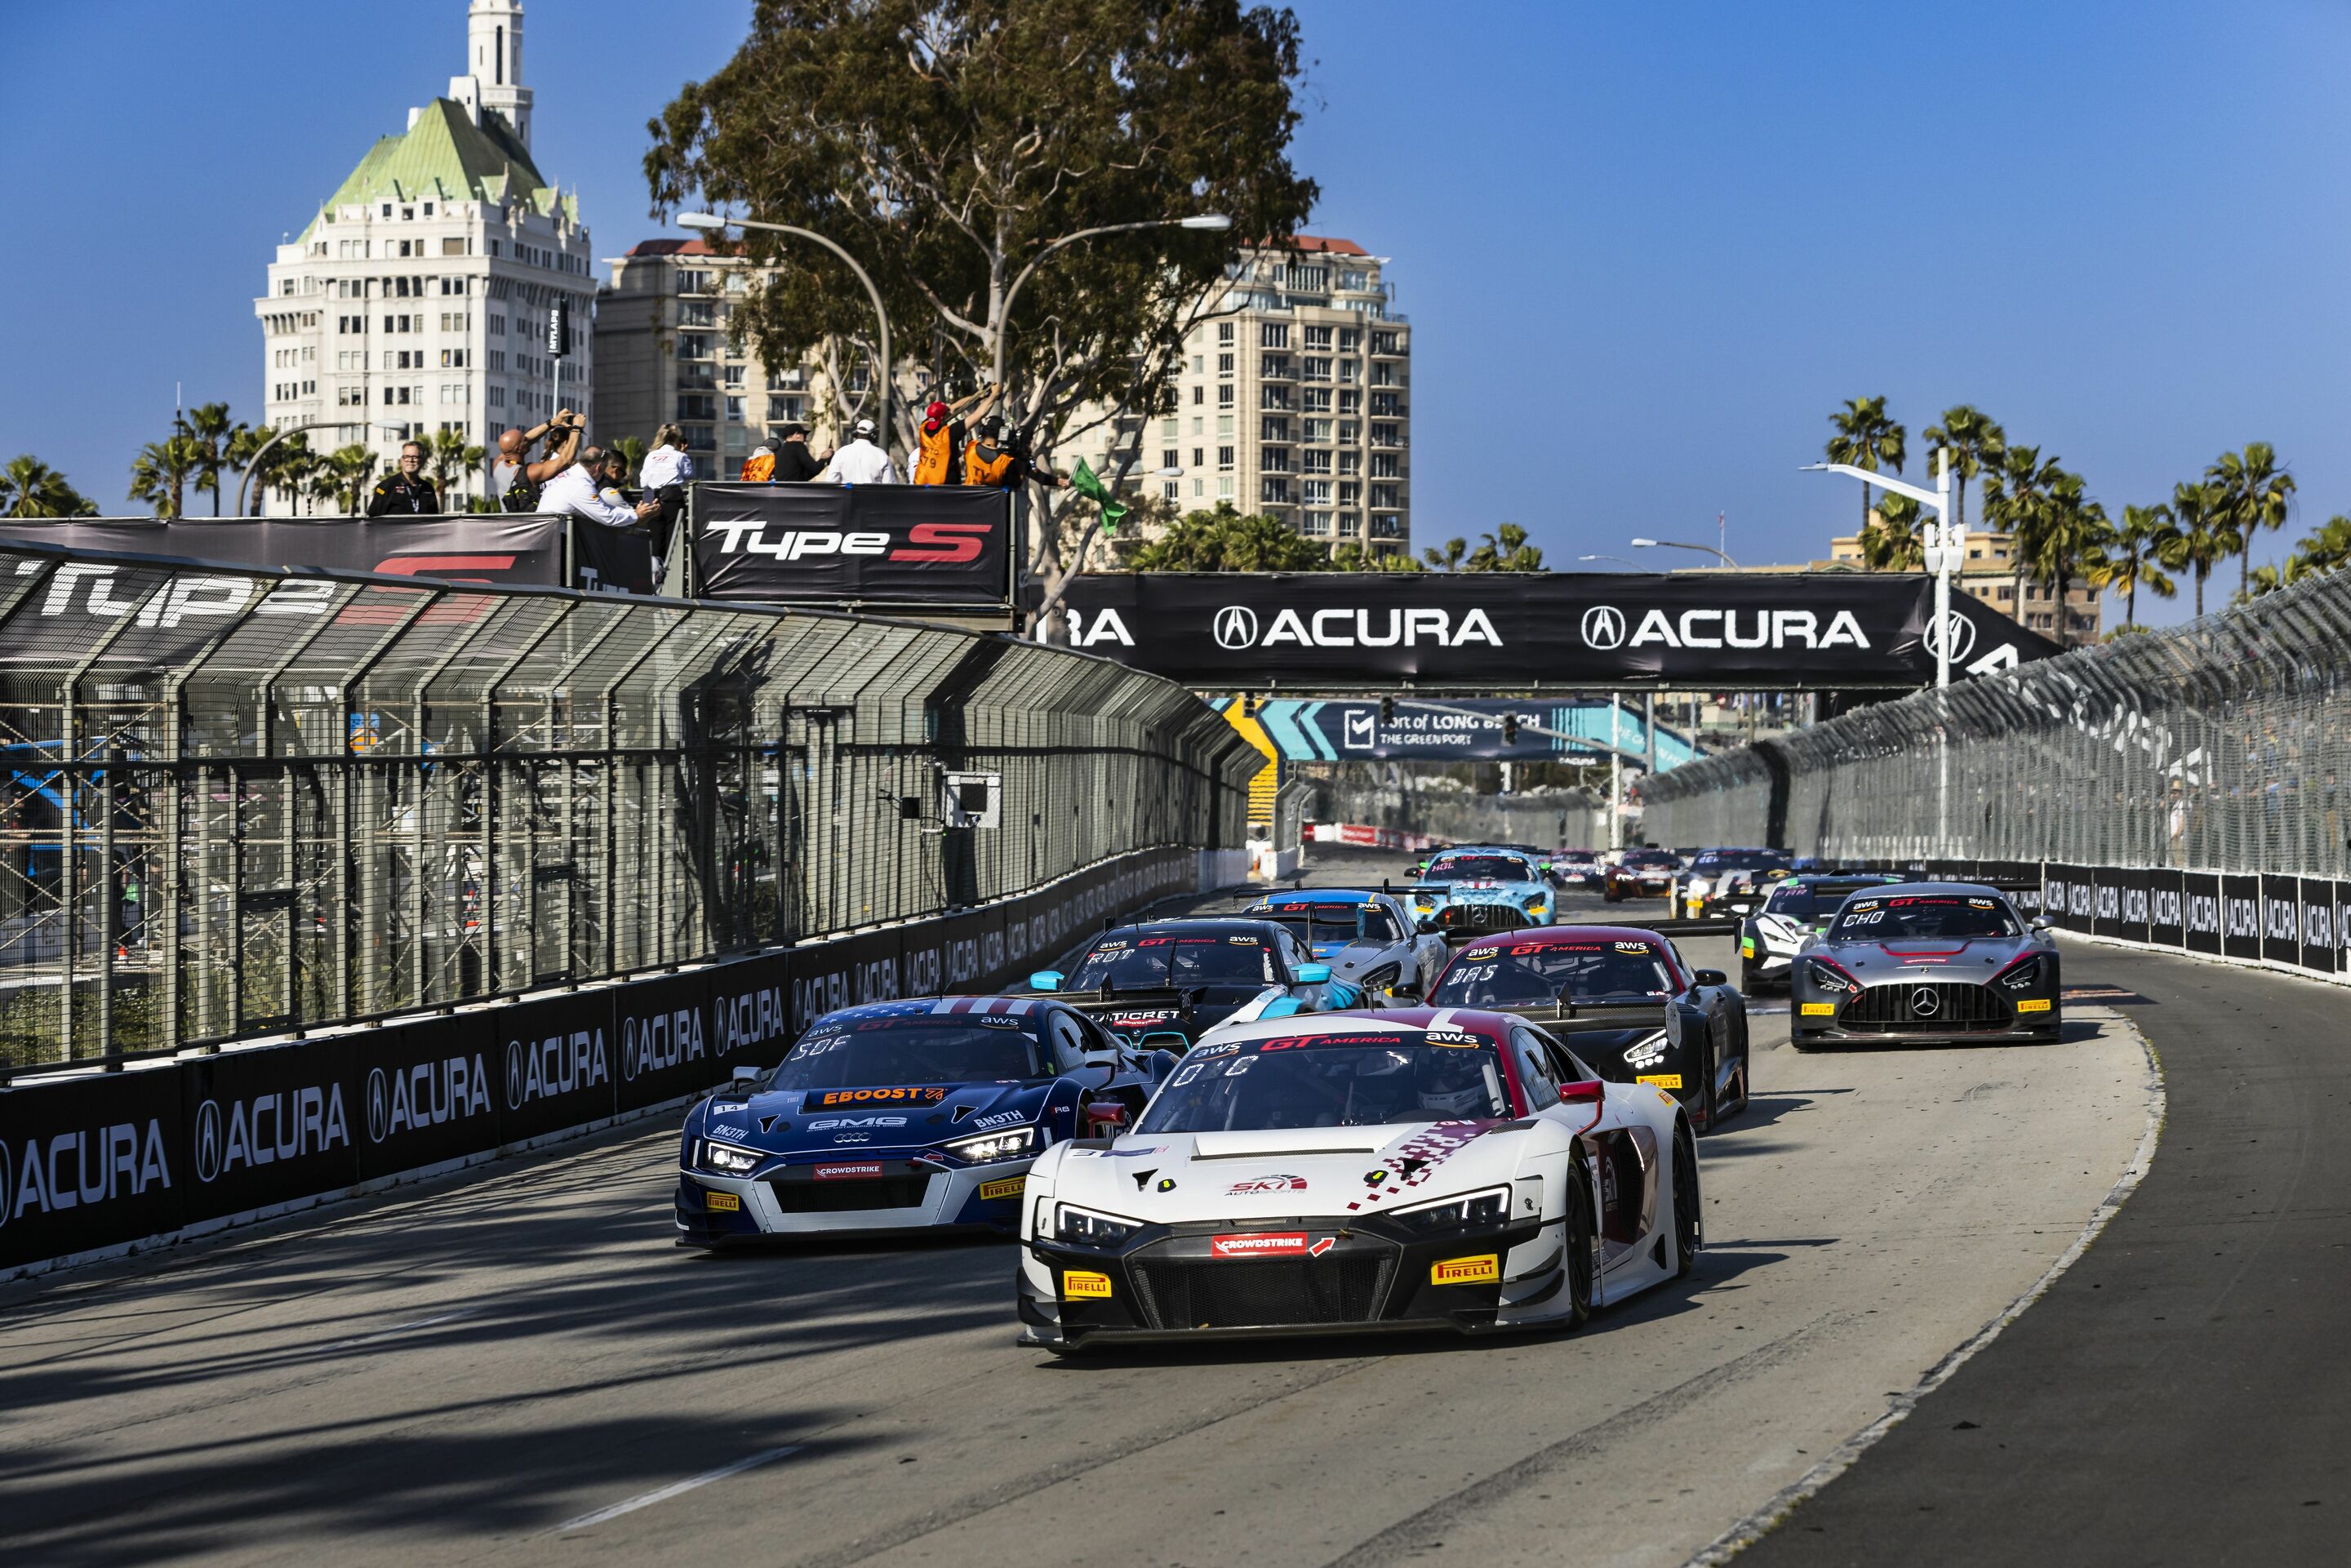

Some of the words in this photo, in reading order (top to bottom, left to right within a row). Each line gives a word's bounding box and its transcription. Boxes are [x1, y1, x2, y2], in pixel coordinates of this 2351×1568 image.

[706, 520, 891, 561] Type
[889, 523, 992, 562] S
[335, 556, 516, 626] S
[1261, 608, 1503, 646] ACURA
[1629, 609, 1871, 649] ACURA
[1413, 713, 1428, 731] of
[1433, 715, 1478, 730] LONG
[1380, 734, 1402, 745] THE
[1404, 734, 1442, 745] GREEN
[1442, 734, 1472, 745] PORT
[1853, 900, 1878, 910] aws
[1889, 898, 1921, 907] GT
[1968, 898, 1993, 906] aws
[1842, 911, 1885, 928] CHO
[1100, 940, 1127, 948] aws
[1138, 938, 1176, 947] GT
[1511, 944, 1553, 955] GT
[1615, 941, 1647, 950] aws
[1469, 947, 1499, 957] aws
[727, 987, 784, 1051] ACURA
[857, 1018, 905, 1031] GT
[980, 1016, 1019, 1025] aws
[809, 1024, 843, 1037] aws
[1425, 1033, 1478, 1044] aws
[638, 1006, 705, 1075] ACURA
[790, 1034, 851, 1061] SOF
[1260, 1035, 1330, 1051] GT
[1319, 1037, 1401, 1045] AMERICA
[1195, 1042, 1242, 1058] aws
[524, 1028, 608, 1102] ACURA
[389, 1053, 491, 1135] ACURA
[823, 1088, 922, 1104] EBOOST
[808, 1117, 908, 1130] GMG
[973, 1109, 1024, 1128] BN3TH
[224, 1082, 349, 1174] ACURA
[713, 1124, 749, 1140] BN3TH
[14, 1118, 171, 1219] ACURA
[820, 1166, 880, 1175] CROWDSTRIKE
[708, 1194, 736, 1209] PIRELLI
[1223, 1237, 1303, 1250] CROWDSTRIKE
[1438, 1259, 1492, 1279] PIRELLI
[1068, 1276, 1106, 1292] PIRELLI
